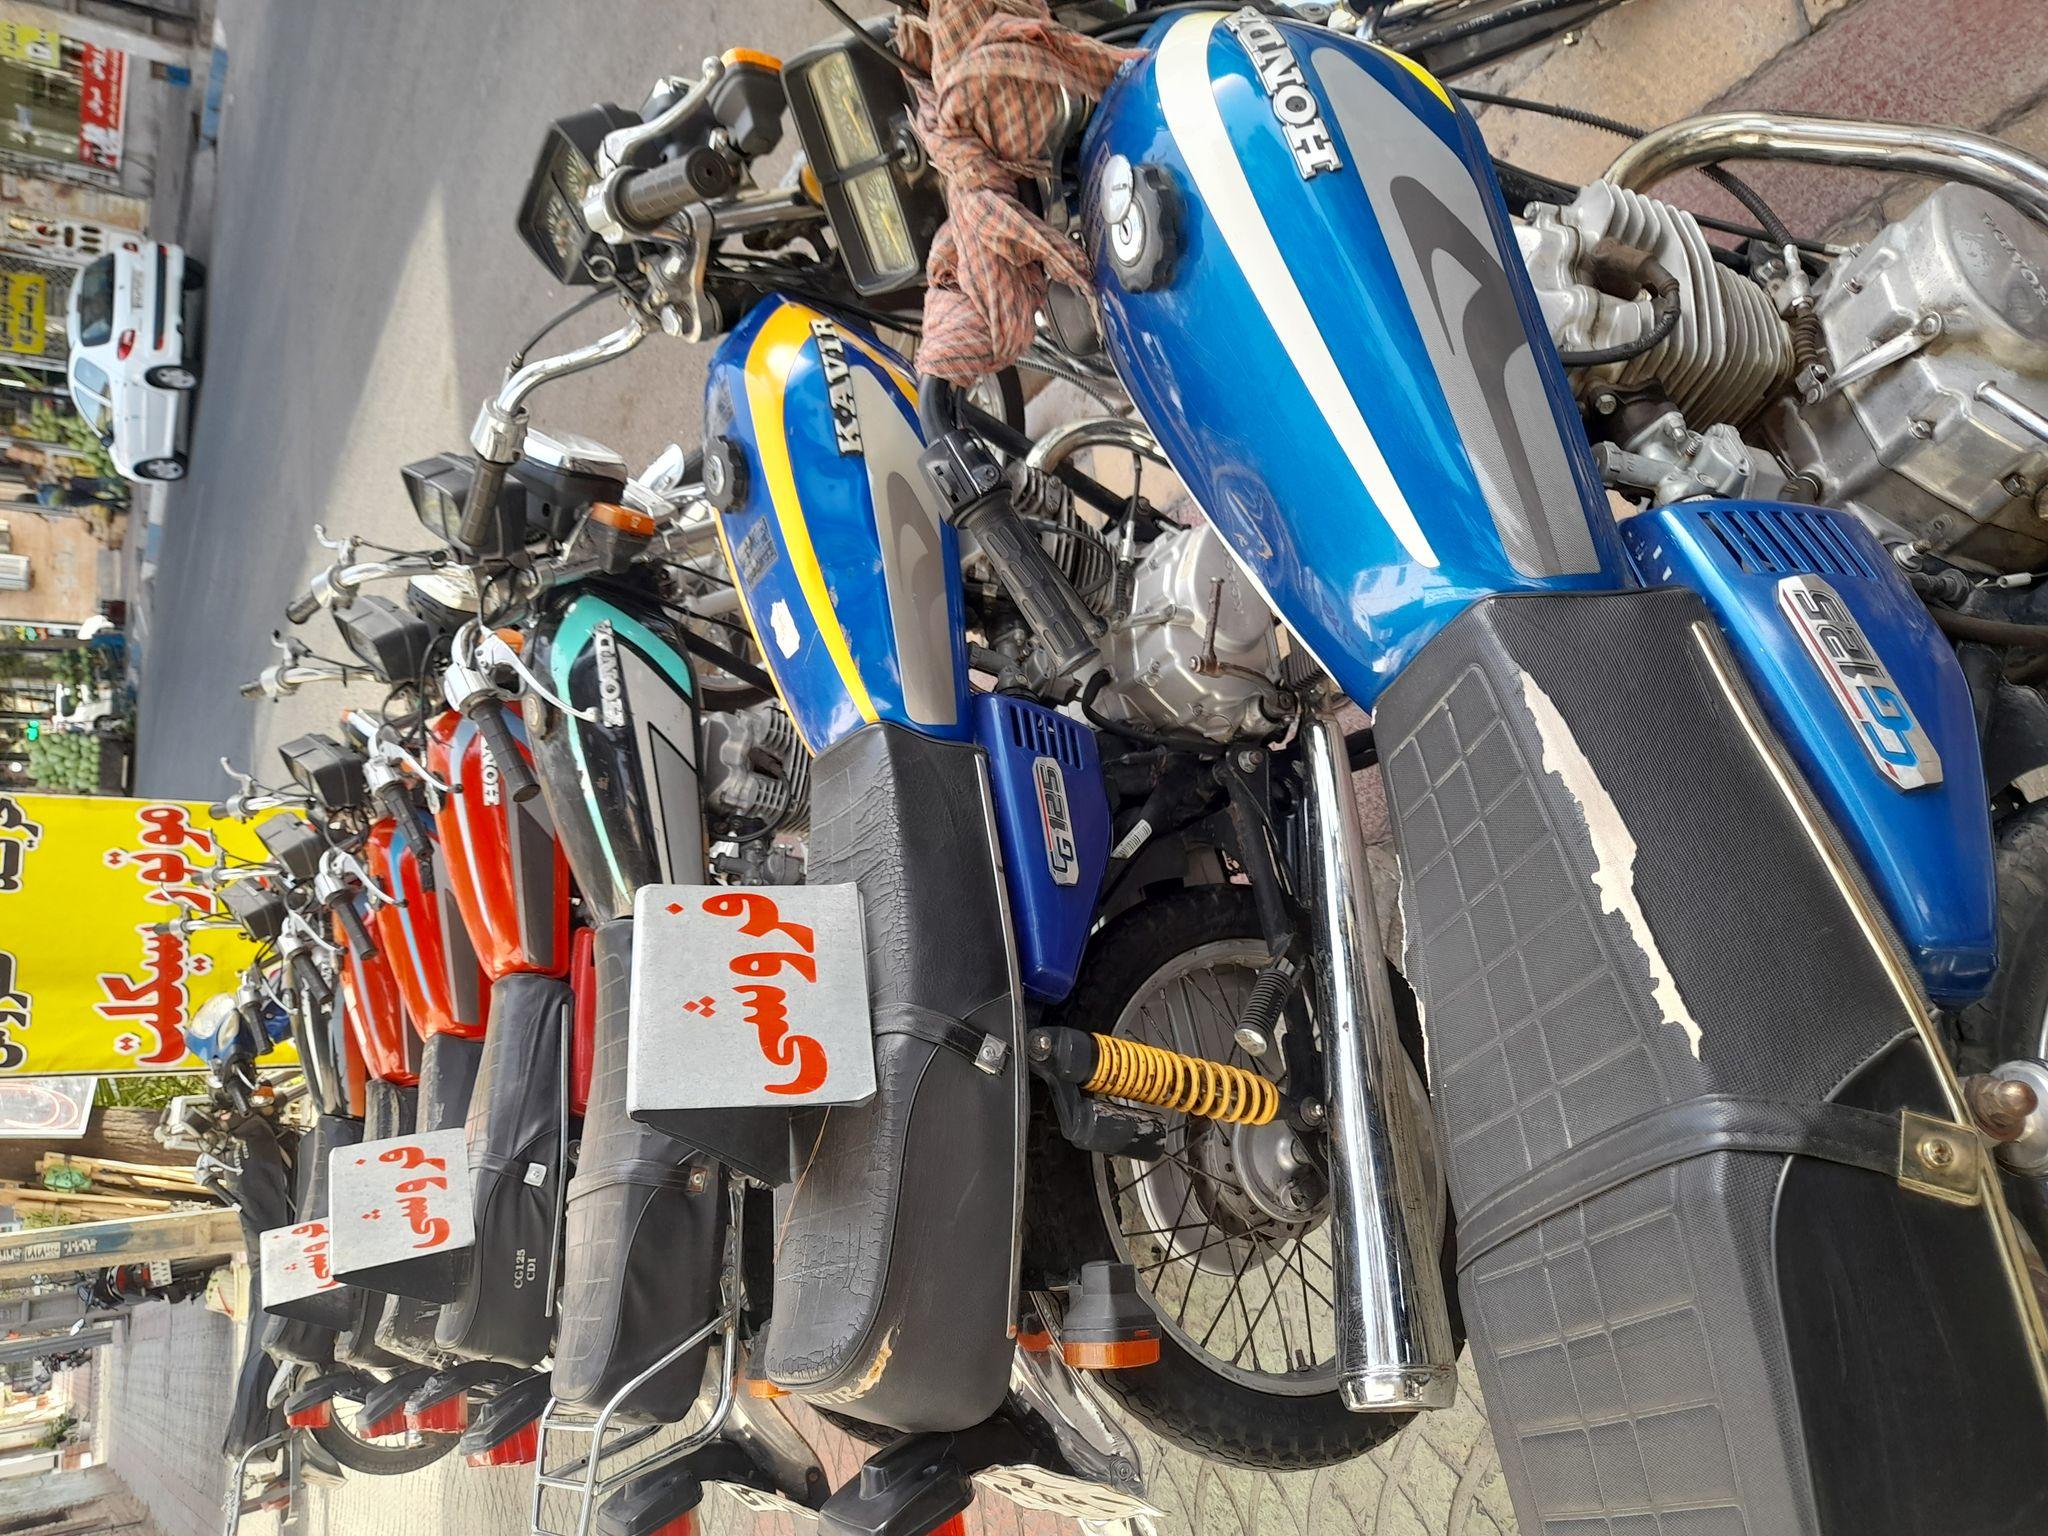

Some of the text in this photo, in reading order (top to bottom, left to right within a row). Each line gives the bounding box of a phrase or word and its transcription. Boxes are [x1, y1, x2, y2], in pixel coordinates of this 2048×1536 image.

[1223, 5, 1343, 179] HONDA
[592, 619, 625, 728] HONDA
[1790, 588, 1919, 768] CG125
[480, 735, 500, 807] HON
[1037, 763, 1075, 874] CG125
[97, 806, 212, 1064] موتور سیکلت
[664, 893, 829, 1095] فروشی
[354, 1146, 450, 1249] فروشی
[513, 1248, 526, 1289] CG125
[526, 1257, 537, 1281] CDI
